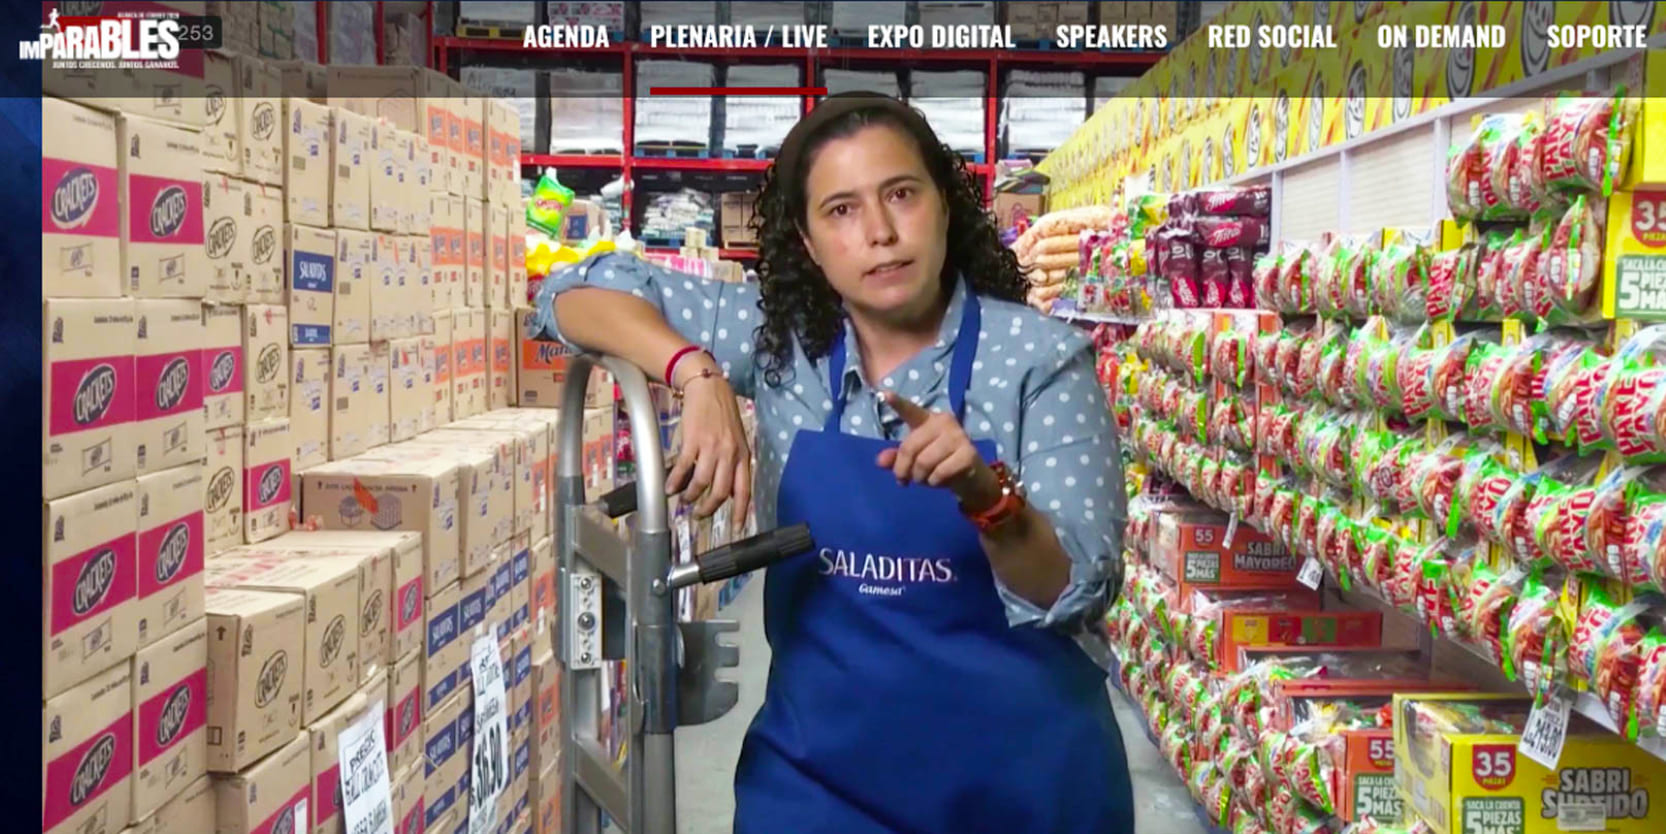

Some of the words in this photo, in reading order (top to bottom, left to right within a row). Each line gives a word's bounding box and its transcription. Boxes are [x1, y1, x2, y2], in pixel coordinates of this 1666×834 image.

[819, 547, 953, 583] SALADITAS
[1475, 752, 1512, 776] 35
[1561, 769, 1630, 792] SABRI
